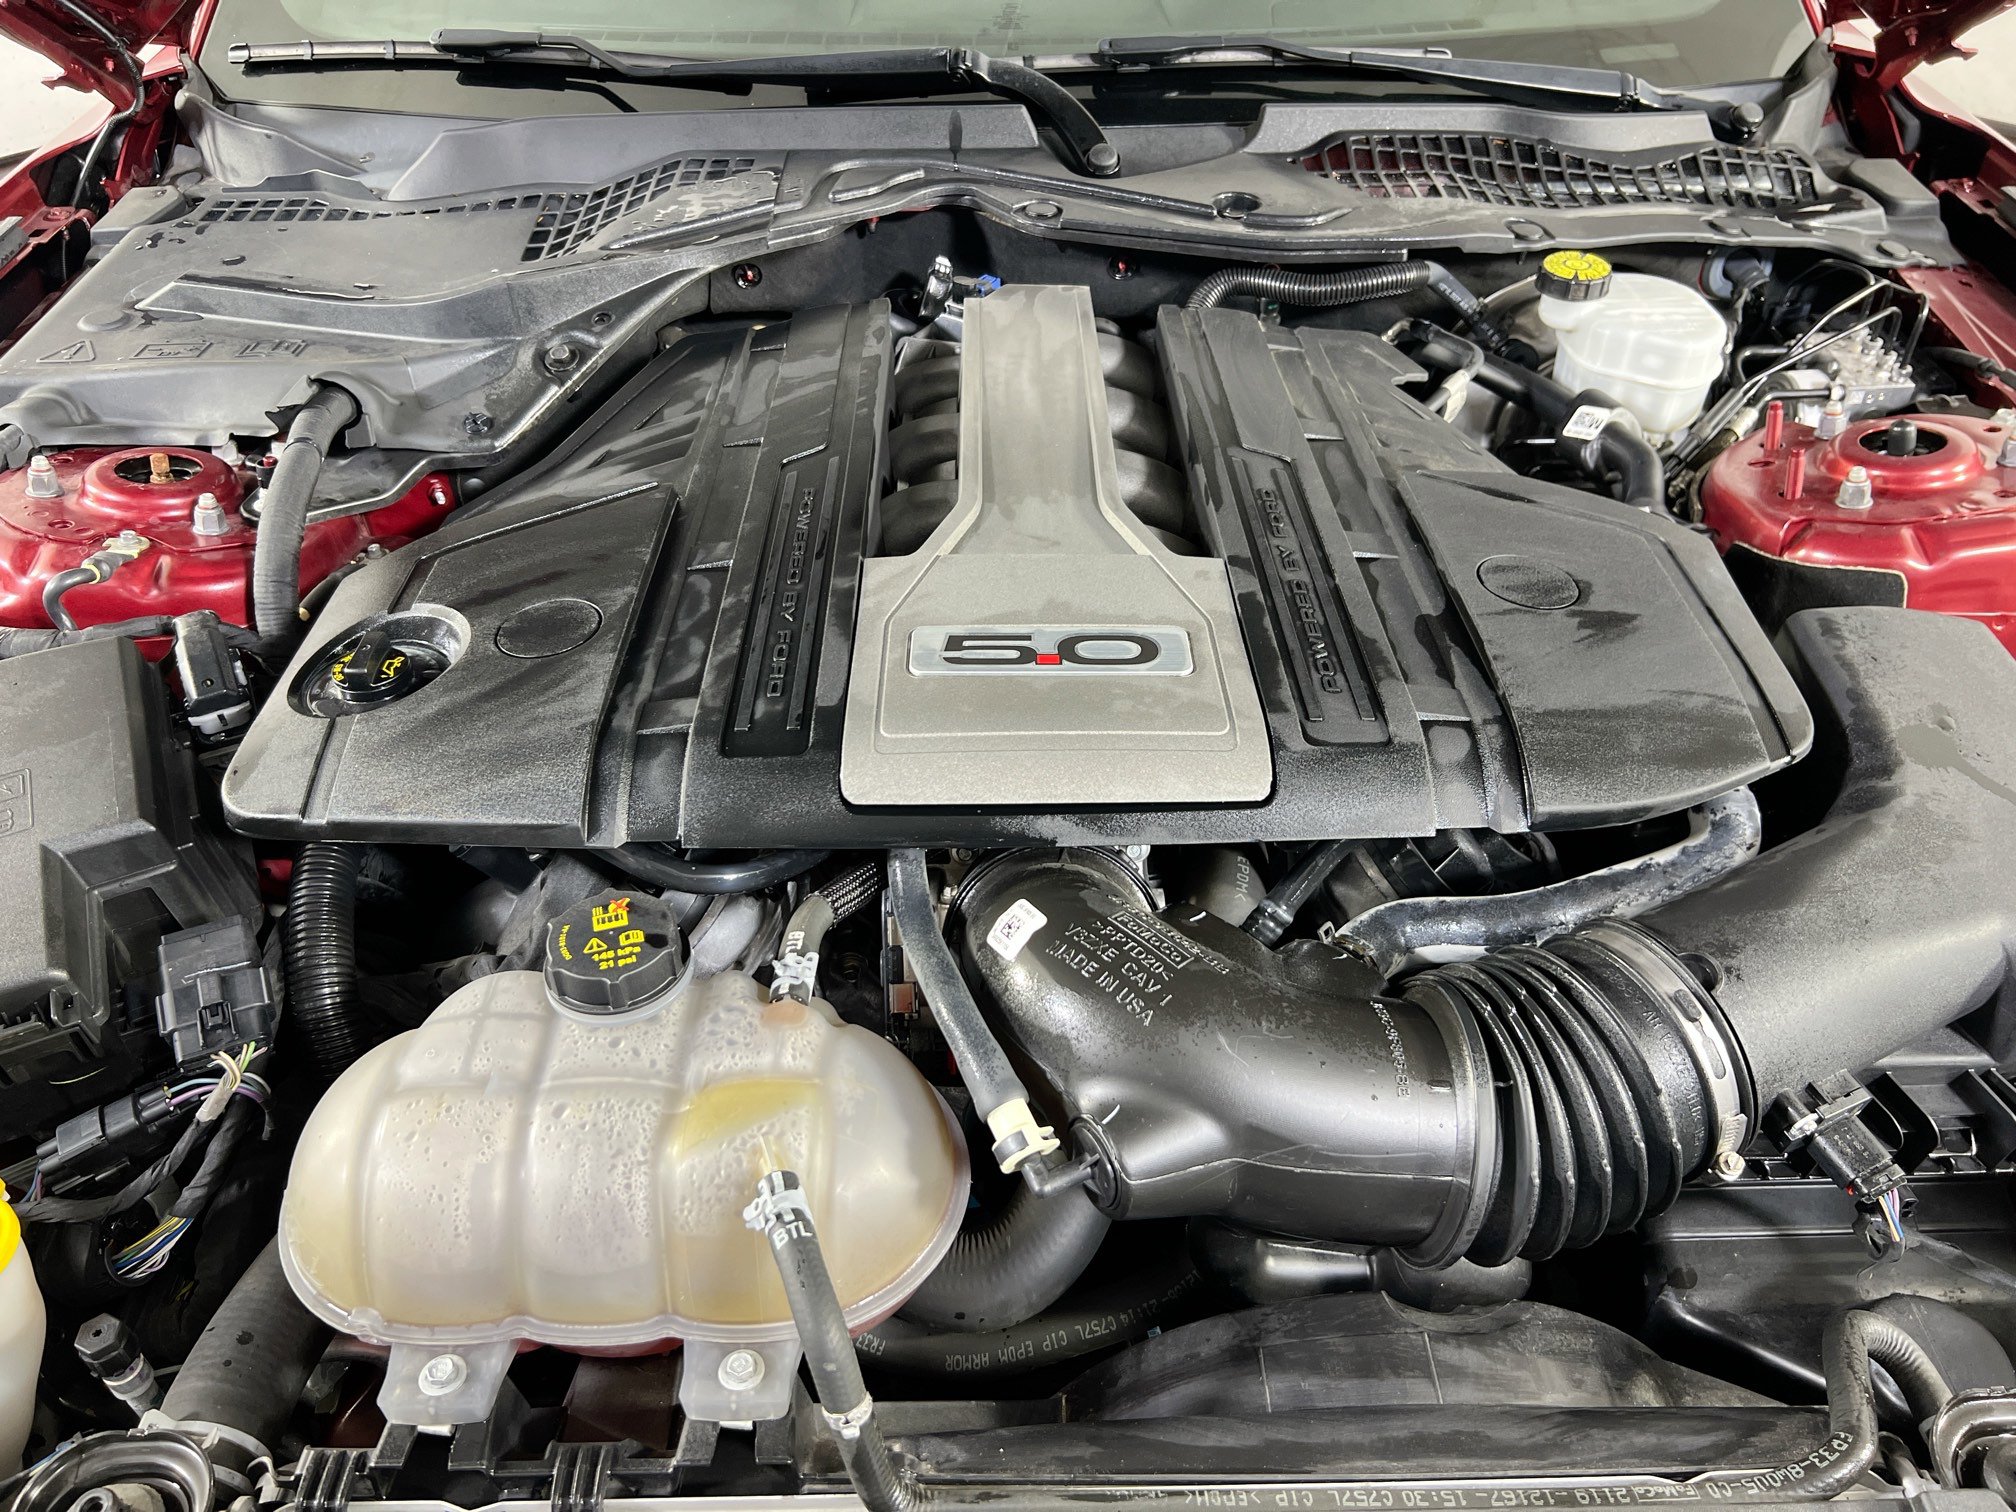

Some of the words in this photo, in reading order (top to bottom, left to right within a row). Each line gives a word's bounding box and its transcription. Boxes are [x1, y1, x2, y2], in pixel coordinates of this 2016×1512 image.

[1259, 488, 1288, 538] FORD
[787, 487, 815, 584] POWERED
[1278, 545, 1300, 572] BY
[780, 592, 798, 622] BY
[942, 634, 1160, 666] 5.0
[1290, 580, 1342, 693] POWERED
[766, 629, 791, 697] FORD
[1114, 912, 1184, 963] FoMoCo
[1045, 939, 1101, 978] MADE
[1095, 970, 1120, 993] IN
[1115, 987, 1154, 1027] USA
[1121, 961, 1162, 993] CAV
[772, 1220, 813, 1250] BTL
[1042, 1329, 1068, 1351] CIP
[1074, 1315, 1117, 1341] C757L
[945, 1353, 990, 1371] ARMOR
[998, 1340, 1035, 1364] EPDM
[1275, 1490, 1313, 1508] CIP
[1327, 1489, 1394, 1508] C757L
